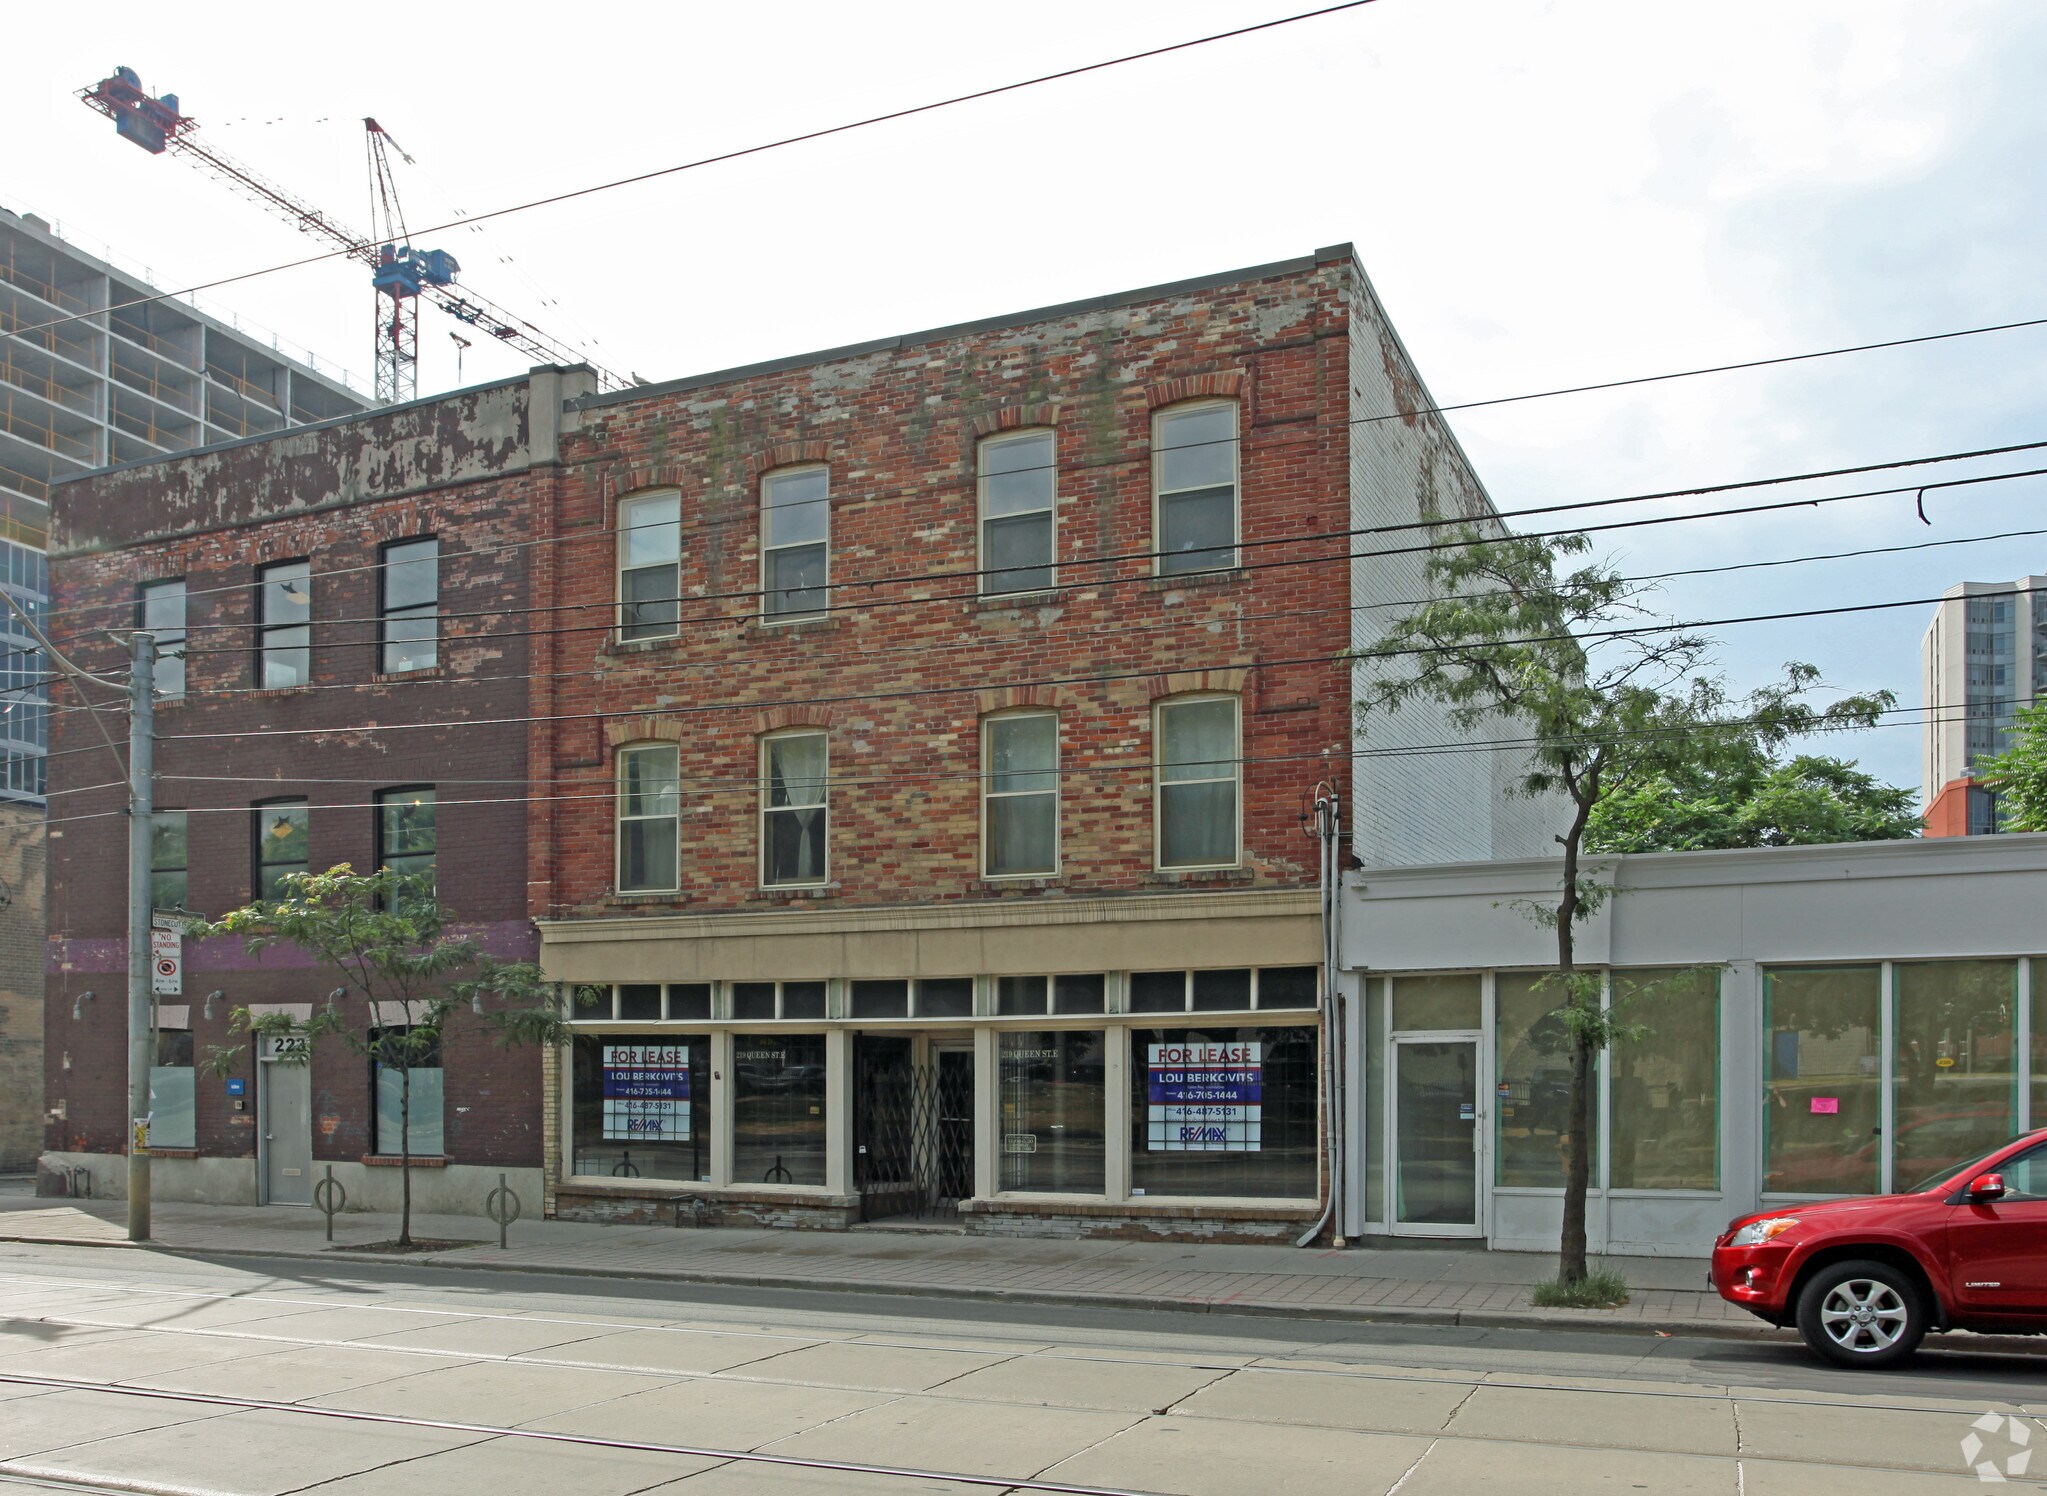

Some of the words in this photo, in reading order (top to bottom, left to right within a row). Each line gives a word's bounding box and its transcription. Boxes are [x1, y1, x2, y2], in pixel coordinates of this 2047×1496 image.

[153, 941, 180, 949] STANDING
[274, 1037, 306, 1053] 223
[611, 1051, 637, 1063] FOR
[641, 1051, 682, 1063] LEASE
[746, 1051, 770, 1060] QUEEN
[1013, 1049, 1040, 1059] QUEEN
[1158, 1048, 1193, 1062] FOR
[1198, 1048, 1252, 1062] LEASE
[611, 1072, 630, 1080] LOU
[633, 1072, 684, 1081] BERKOVITS
[1159, 1073, 1184, 1083] LOU
[1187, 1073, 1254, 1082] BERKOVITS
[1177, 1091, 1238, 1100] 416-705-1444
[625, 1102, 671, 1110] 416-487-5131
[1176, 1107, 1236, 1116] 416-487-5131
[628, 1117, 664, 1132] RE/MAX
[1180, 1126, 1226, 1141] RE/MAX
